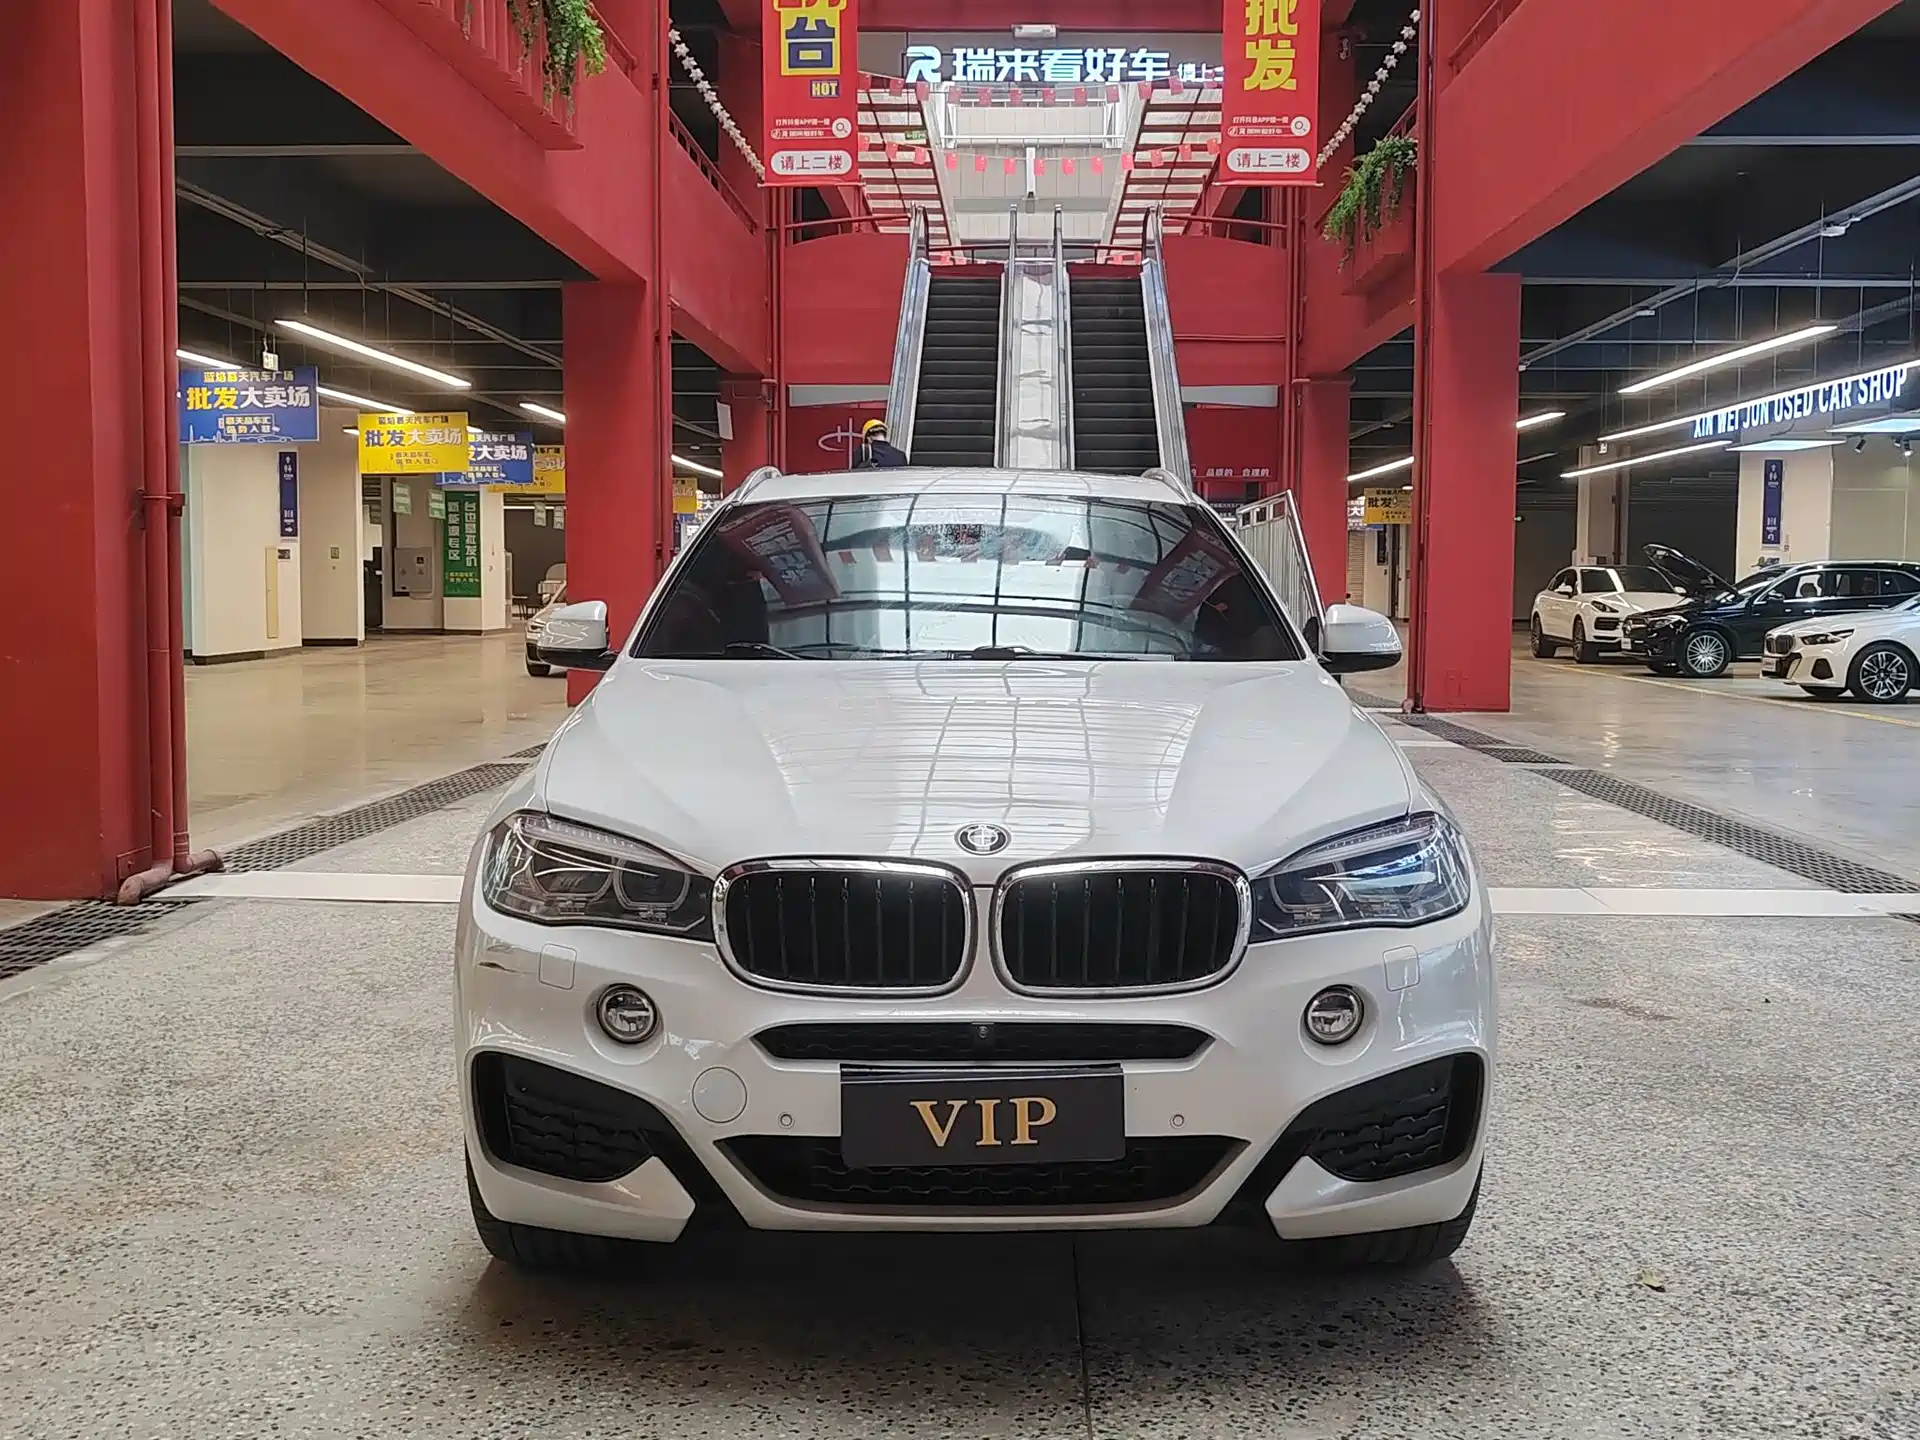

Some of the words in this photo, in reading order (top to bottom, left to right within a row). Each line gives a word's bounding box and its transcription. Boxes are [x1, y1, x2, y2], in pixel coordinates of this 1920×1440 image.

[1243, 0, 1298, 91] 批发
[952, 48, 1171, 82] 瑞来看好车
[811, 81, 838, 97] HOT
[780, 155, 843, 170] 请上二楼
[1236, 153, 1300, 168] 请上二楼
[186, 386, 311, 410] 批发大卖场
[1693, 414, 1713, 438] XIN
[1718, 409, 1739, 434] WEI
[1743, 404, 1769, 429] JUN
[1774, 391, 1812, 422] USED
[1819, 381, 1851, 413] CAR
[1857, 367, 1908, 405] SHOP
[365, 428, 462, 447] 批发大卖场
[909, 1097, 1057, 1147] VIP
